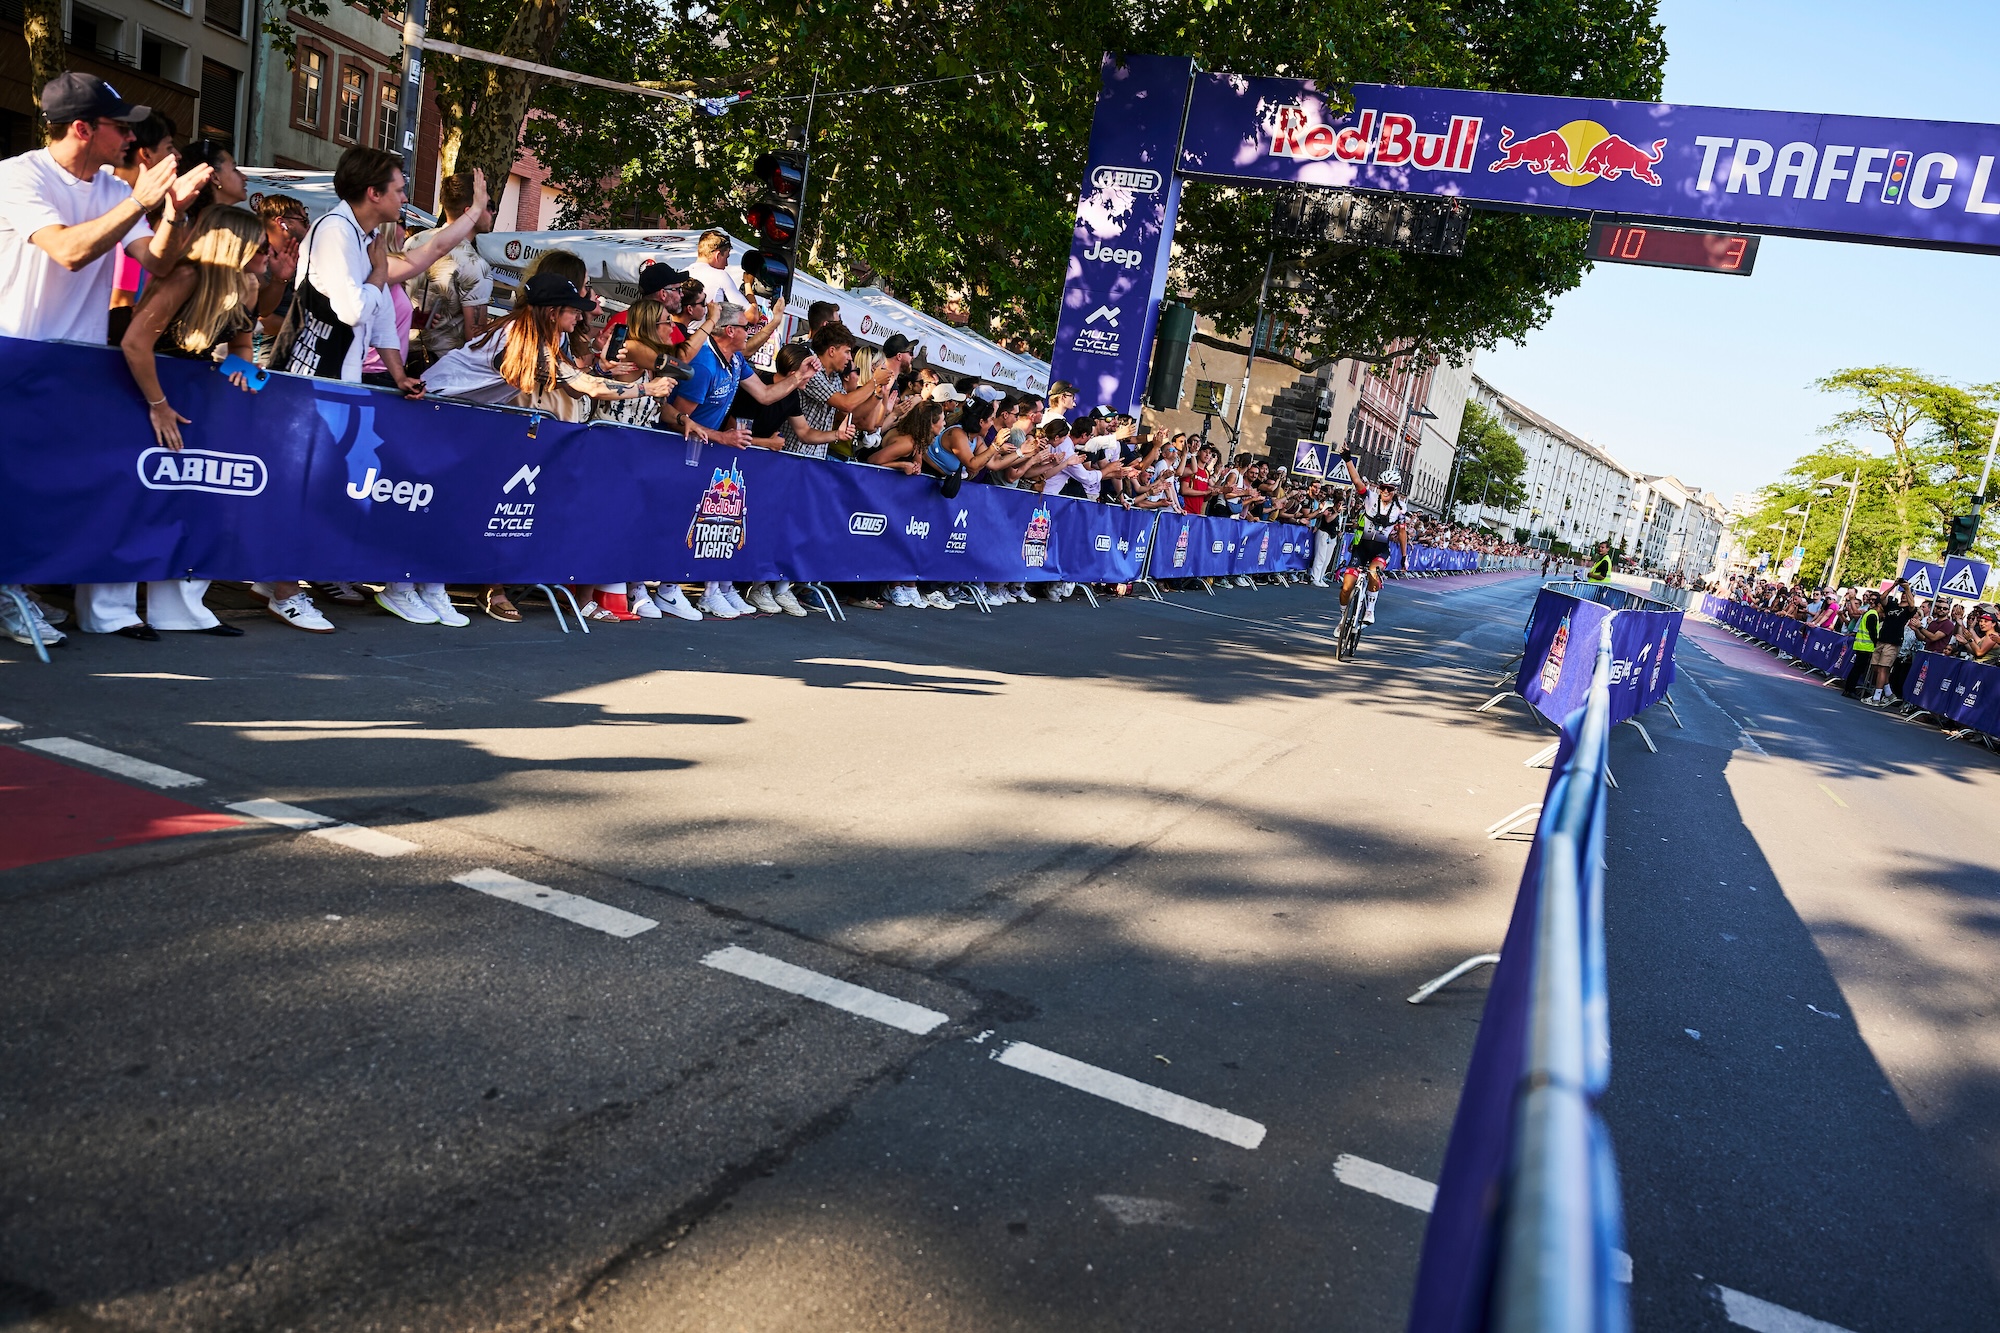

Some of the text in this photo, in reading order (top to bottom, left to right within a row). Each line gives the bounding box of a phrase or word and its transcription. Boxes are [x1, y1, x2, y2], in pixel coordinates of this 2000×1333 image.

[1270, 105, 1481, 172] Red Bull
[1099, 170, 1154, 189] ABUS
[1695, 136, 1958, 209] TRAFFIC
[1084, 241, 1142, 269] Jeep
[1609, 228, 1748, 269] 10 3
[1075, 338, 1120, 351] CYCLE
[1080, 329, 1120, 341] MULTI
[153, 457, 254, 488] ABUS
[347, 468, 434, 512] Jeep
[494, 503, 535, 515] MULTI
[702, 498, 742, 516] Red Bull
[488, 518, 534, 529] CYCLE
[695, 523, 741, 543] TRAFFIC
[852, 517, 884, 531] ABUS
[905, 516, 930, 539] Jeep
[694, 541, 734, 559] LIGHTS
[946, 541, 967, 549] CYCLE
